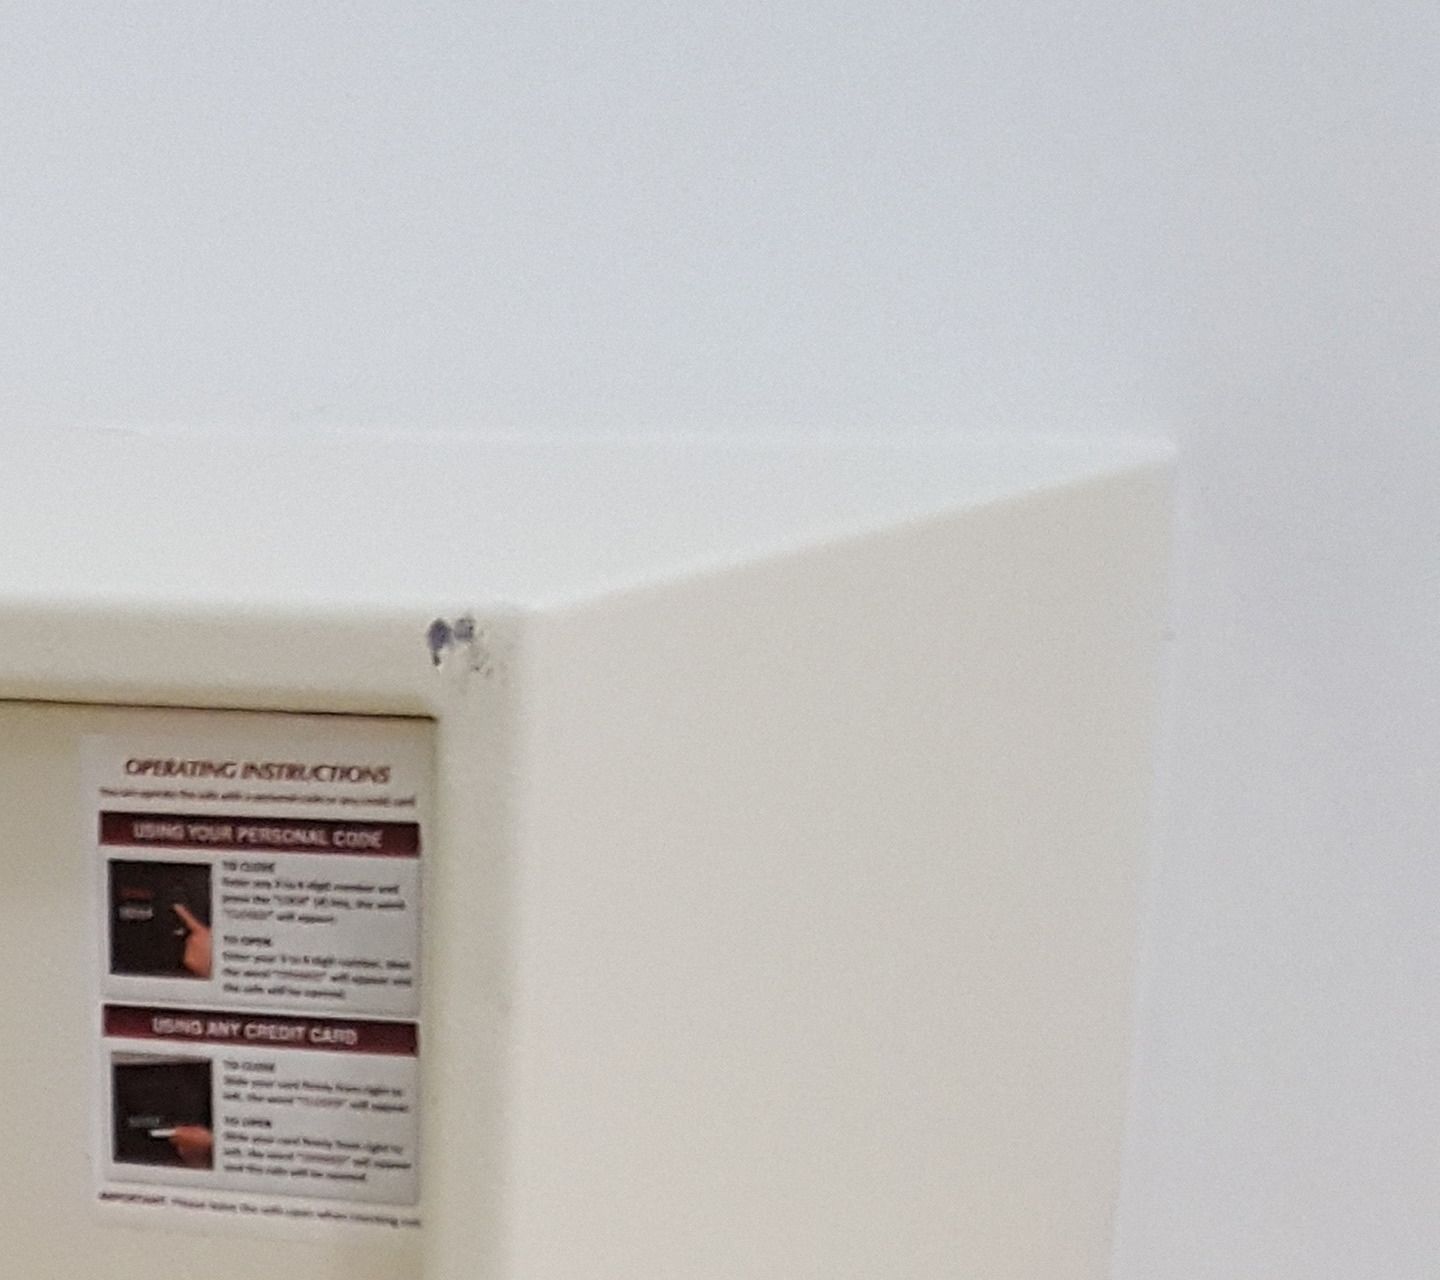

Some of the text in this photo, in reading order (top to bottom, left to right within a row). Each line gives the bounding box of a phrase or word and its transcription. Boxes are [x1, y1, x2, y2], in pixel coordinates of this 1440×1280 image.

[124, 758, 391, 784] OPERATING INSTRUCTIONS
[133, 822, 383, 849] USING YOUR PERSONAL CODE
[153, 1017, 358, 1045] USING ANY CREDIT CARD
